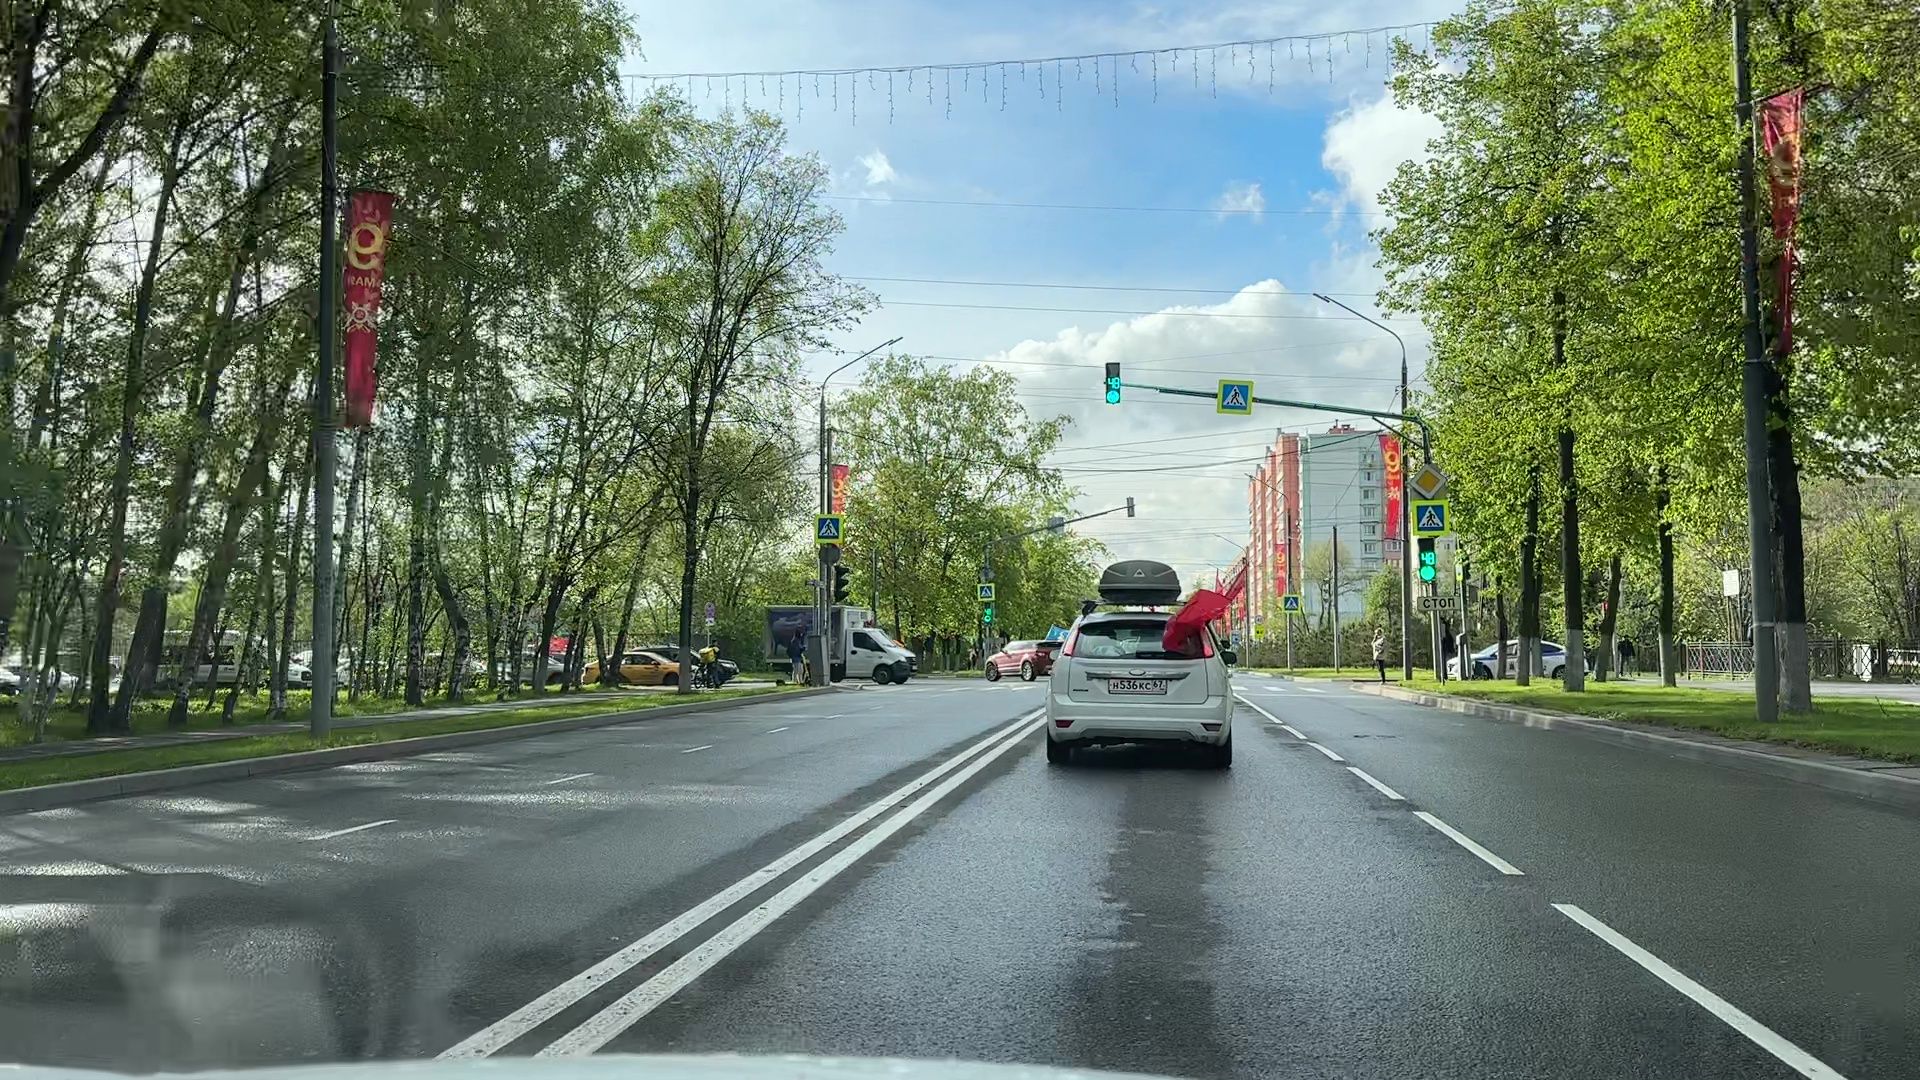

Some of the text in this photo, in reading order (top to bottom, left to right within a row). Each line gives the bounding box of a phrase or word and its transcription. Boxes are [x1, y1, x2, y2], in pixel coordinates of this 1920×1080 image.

[1108, 377, 1120, 390] 48
[1384, 451, 1399, 472] 9
[1421, 552, 1435, 565] 48
[1423, 598, 1455, 609] СТОП
